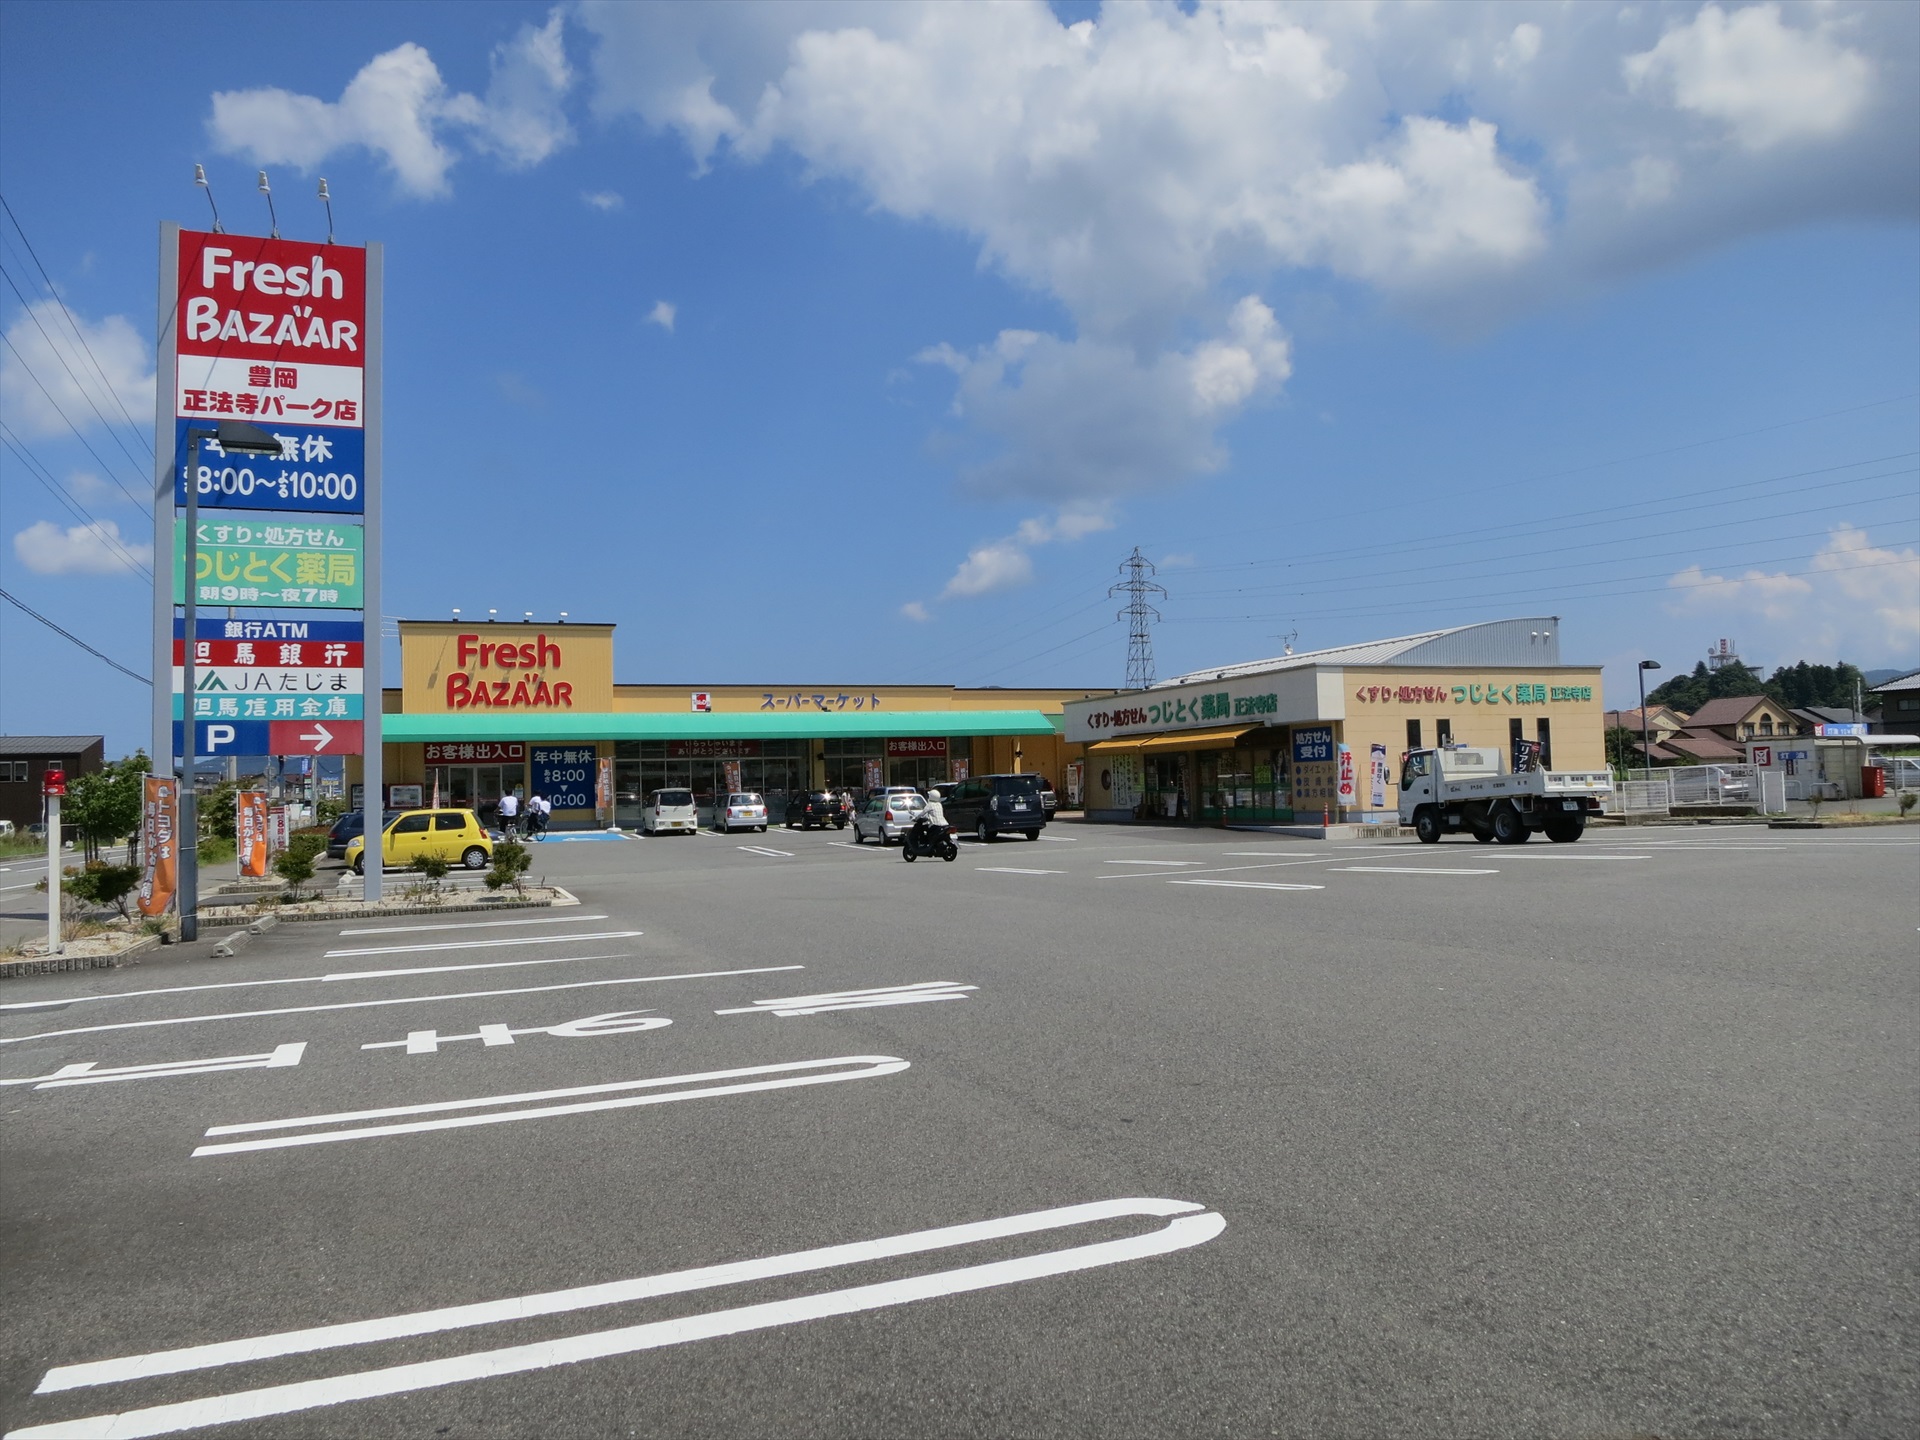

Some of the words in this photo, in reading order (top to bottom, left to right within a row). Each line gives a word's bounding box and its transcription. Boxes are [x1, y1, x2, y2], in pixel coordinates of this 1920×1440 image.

[202, 246, 343, 299] Fresh
[248, 365, 298, 389] 豊岡
[183, 388, 357, 421] 正法寺パーク店
[184, 550, 355, 586] つじとく薬局
[224, 620, 309, 639] 銀行ATM
[457, 634, 561, 668] Fresh
[234, 671, 349, 691] JAたじま
[760, 693, 881, 711] スーパーマーケット
[1355, 685, 1448, 706] くすり・処方せん
[1451, 683, 1546, 706] つじとく薬局
[1550, 686, 1591, 703] 正法寺店
[1087, 707, 1147, 729] くすり・処方せん
[1148, 692, 1231, 725] つじとく薬局
[1233, 693, 1278, 717] 正法寺店
[207, 724, 235, 752] P
[888, 741, 946, 752] お客様出入口
[1296, 730, 1331, 745] 処方せん
[426, 744, 523, 760] お客様出入口
[534, 750, 593, 764] 年中無休
[1300, 745, 1327, 759] 受付
[1340, 751, 1353, 795] 汗止め
